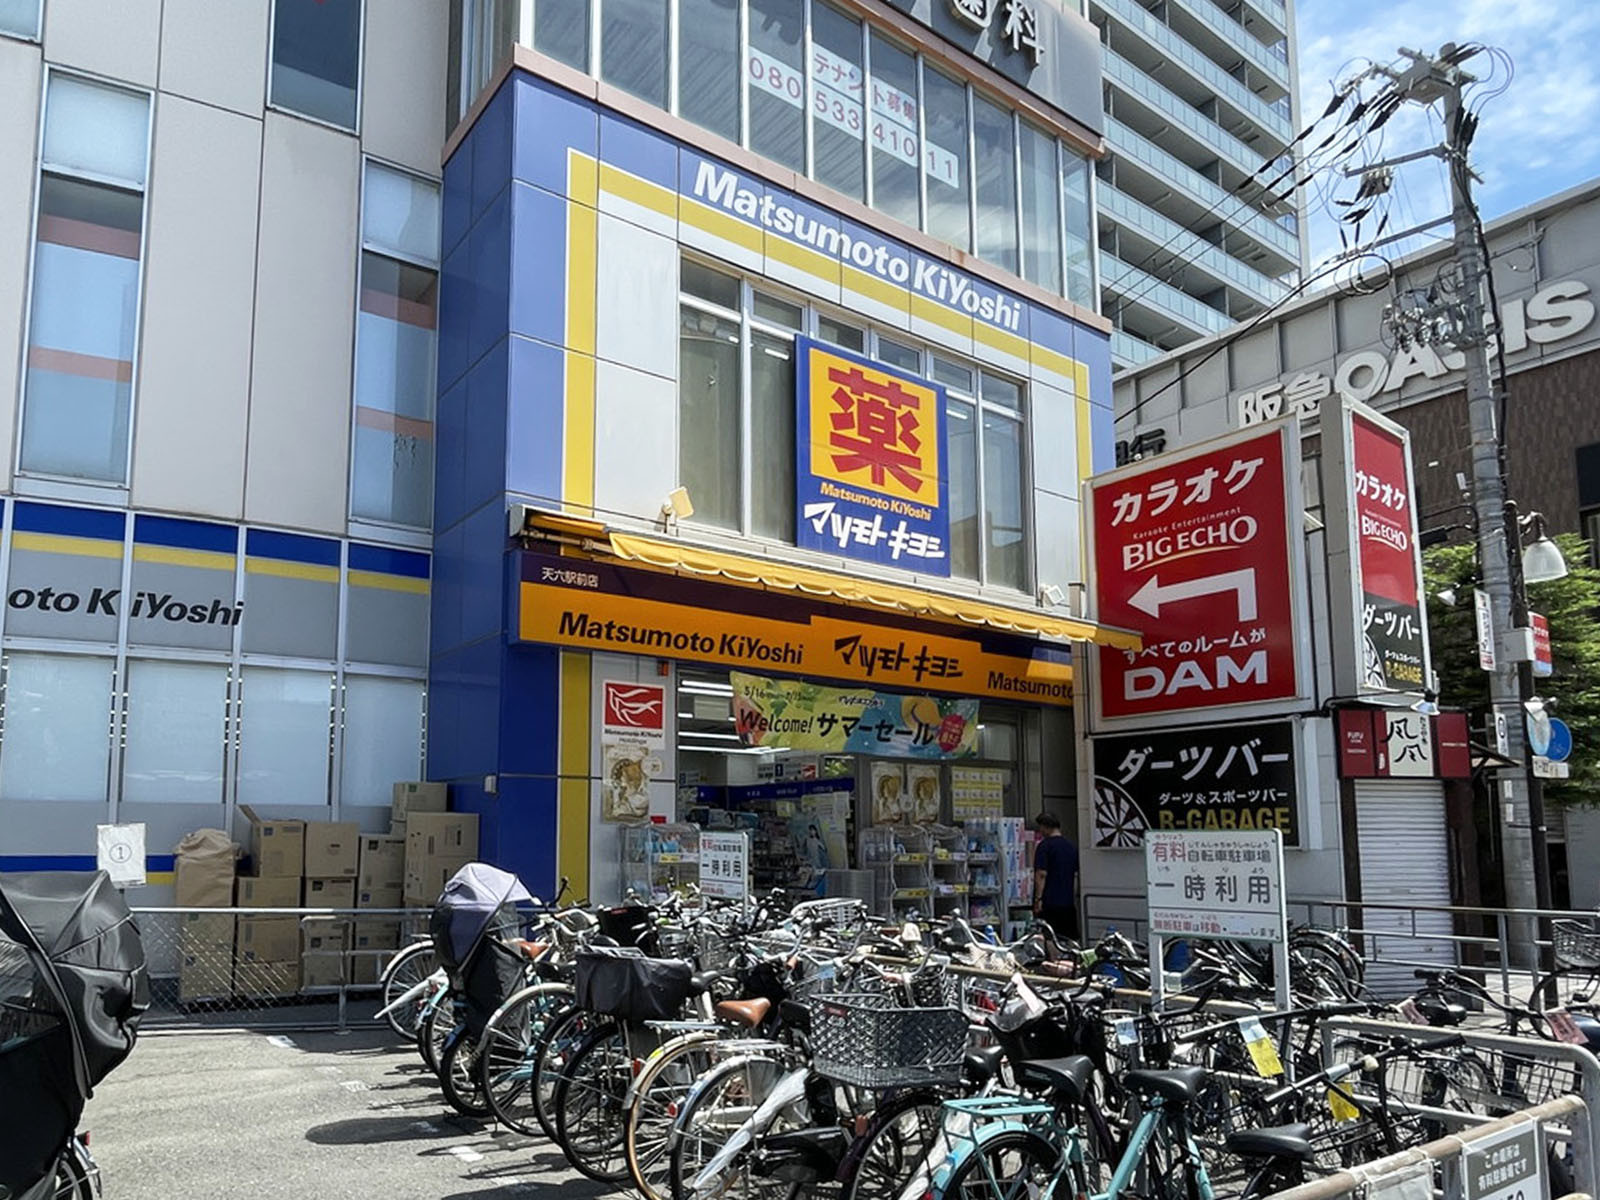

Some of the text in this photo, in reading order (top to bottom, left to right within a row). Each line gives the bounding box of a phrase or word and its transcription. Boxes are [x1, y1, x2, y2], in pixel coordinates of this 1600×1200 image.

[749, 57, 953, 179] 080 533 410 11
[694, 161, 1020, 332] Matsumoto KiYoshi
[828, 367, 923, 494] 薬
[820, 482, 932, 521] Matsumoto KiYoshi
[1111, 457, 1264, 527] カラオケ
[1356, 470, 1406, 511] カラオケ
[804, 502, 945, 560] マツモトキヨシ
[1122, 516, 1258, 572] BIG ECHO
[1133, 506, 1241, 540] Karaoke Entertainment
[1361, 514, 1381, 536] BIG
[1381, 524, 1408, 551] ECHO
[8, 587, 80, 613] oto
[542, 566, 598, 588] 天六駅前店
[558, 611, 804, 665] Matsumoto KiYoshi
[1362, 604, 1420, 640] ダーツバー
[834, 634, 963, 682] マツモトキヨシ
[1124, 650, 1268, 701] DAM
[740, 708, 814, 734] Welcome!
[817, 712, 934, 746] サマーセール
[1118, 738, 1289, 785] ダーツバー
[1155, 874, 1271, 904] 一時利用
